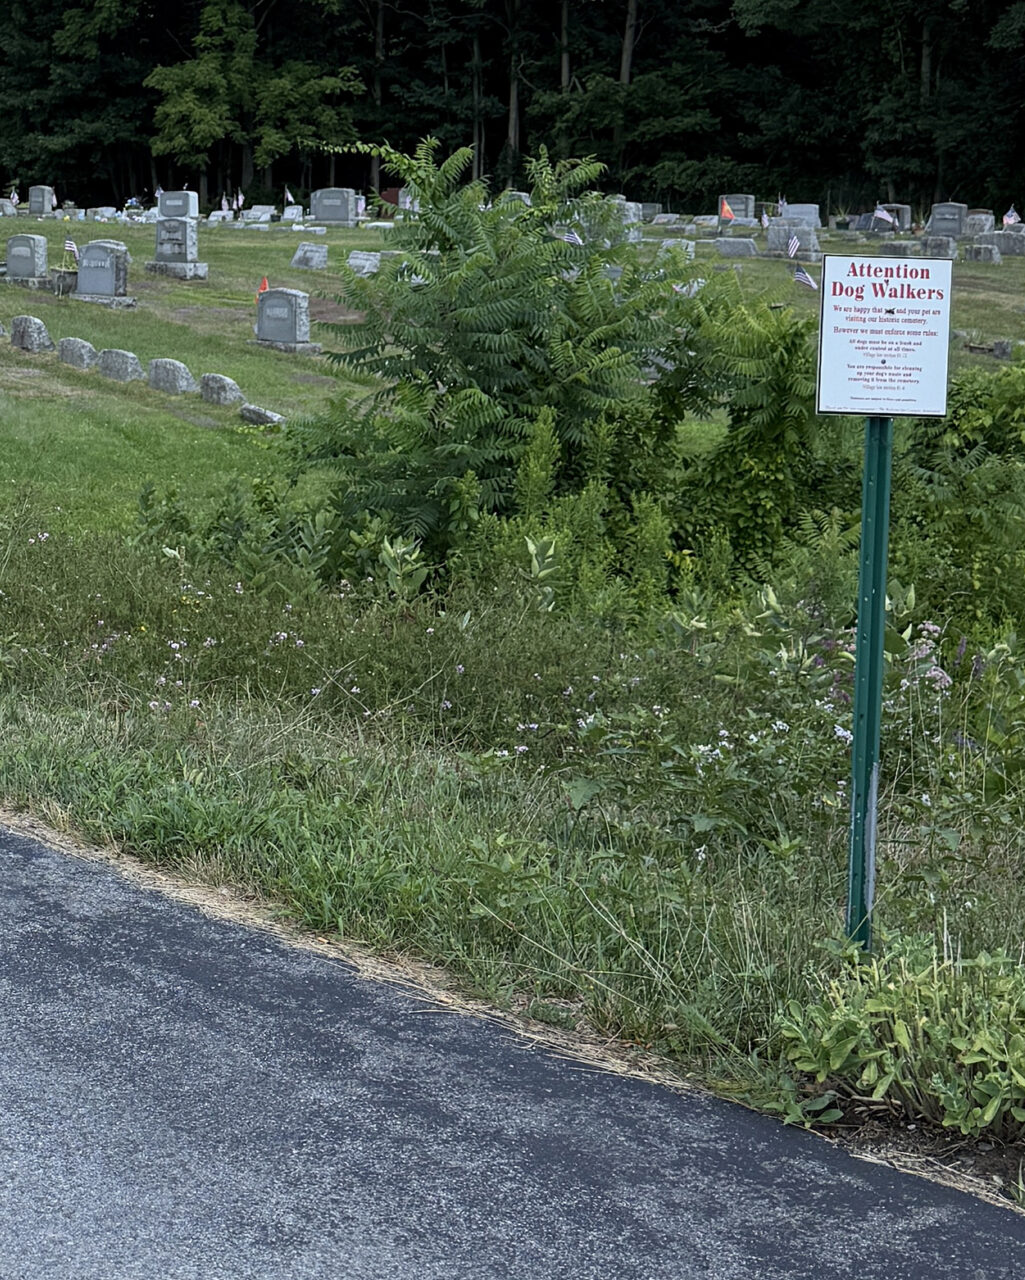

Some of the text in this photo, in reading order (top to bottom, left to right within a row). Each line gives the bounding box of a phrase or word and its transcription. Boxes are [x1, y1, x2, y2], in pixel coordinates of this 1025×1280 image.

[847, 262, 930, 279] Attention
[832, 282, 944, 301] Dog Walkers
